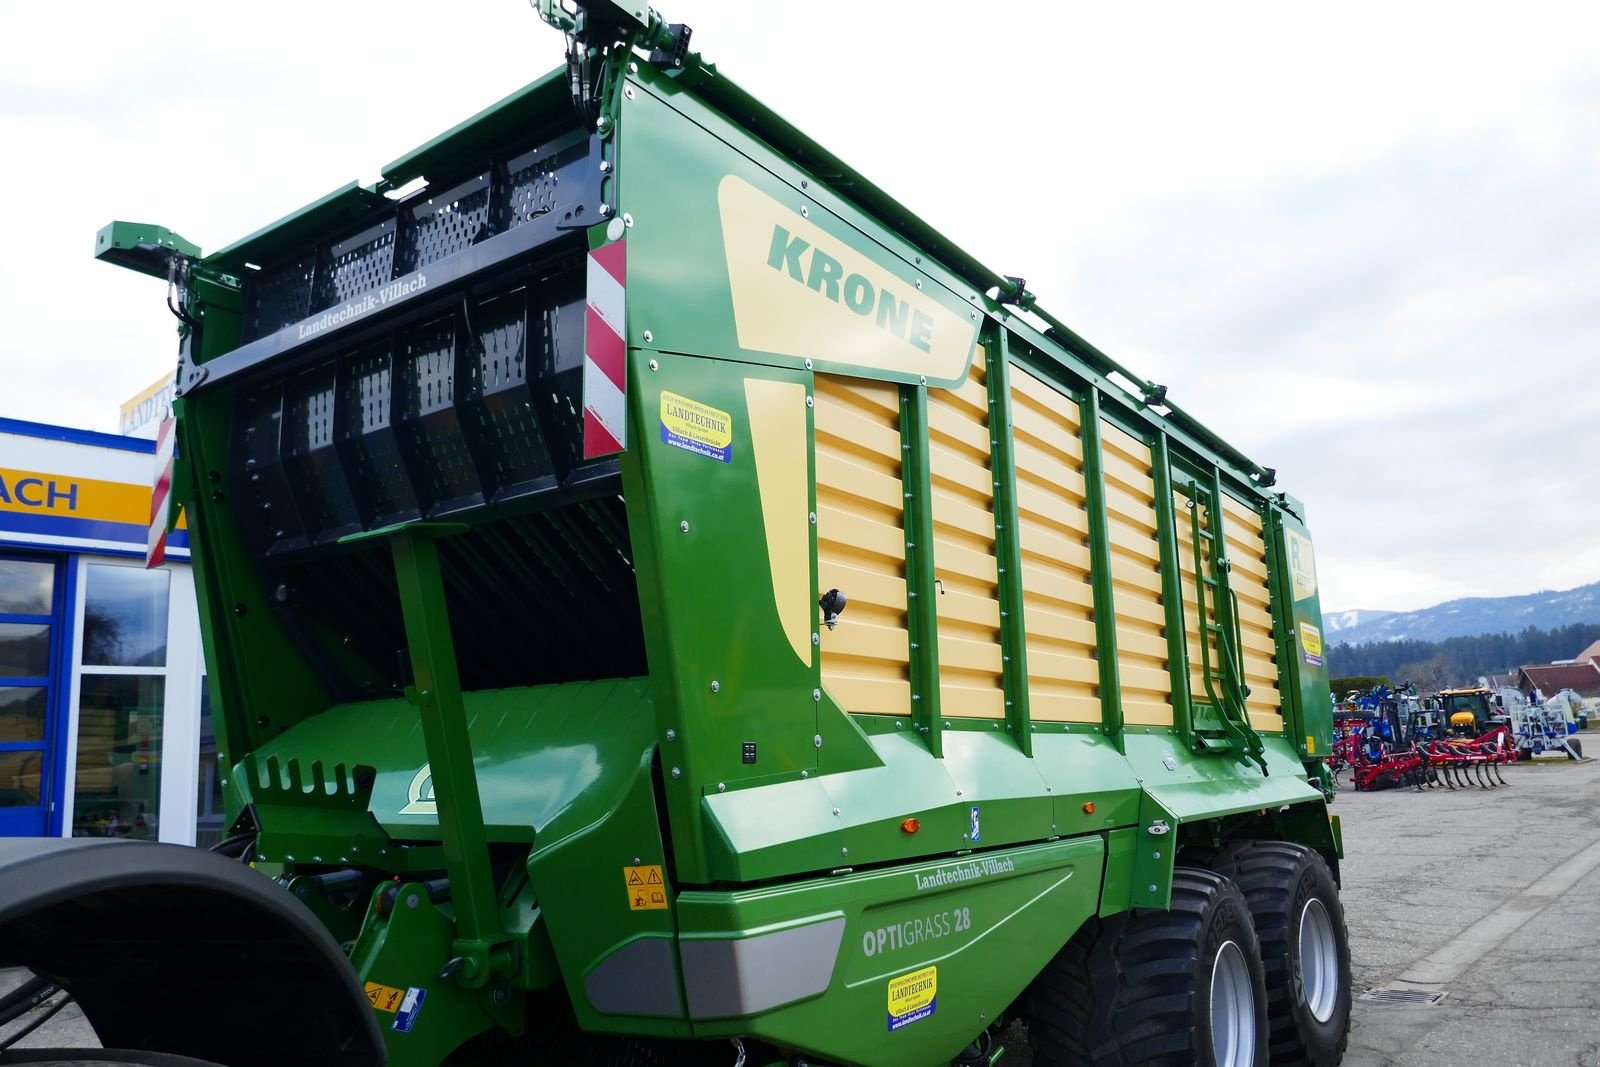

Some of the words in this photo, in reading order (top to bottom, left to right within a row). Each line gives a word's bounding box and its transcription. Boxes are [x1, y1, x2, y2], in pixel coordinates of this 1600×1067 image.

[298, 272, 427, 339] Landtechnik-Villach
[767, 224, 934, 354] KRONE
[666, 403, 726, 433] LANDTECHNIK
[915, 857, 1015, 890] Landtechnik-Villach
[863, 912, 951, 957] OPTIGRASS
[954, 907, 971, 932] 28
[891, 976, 932, 1001] LANDTECHNIK
